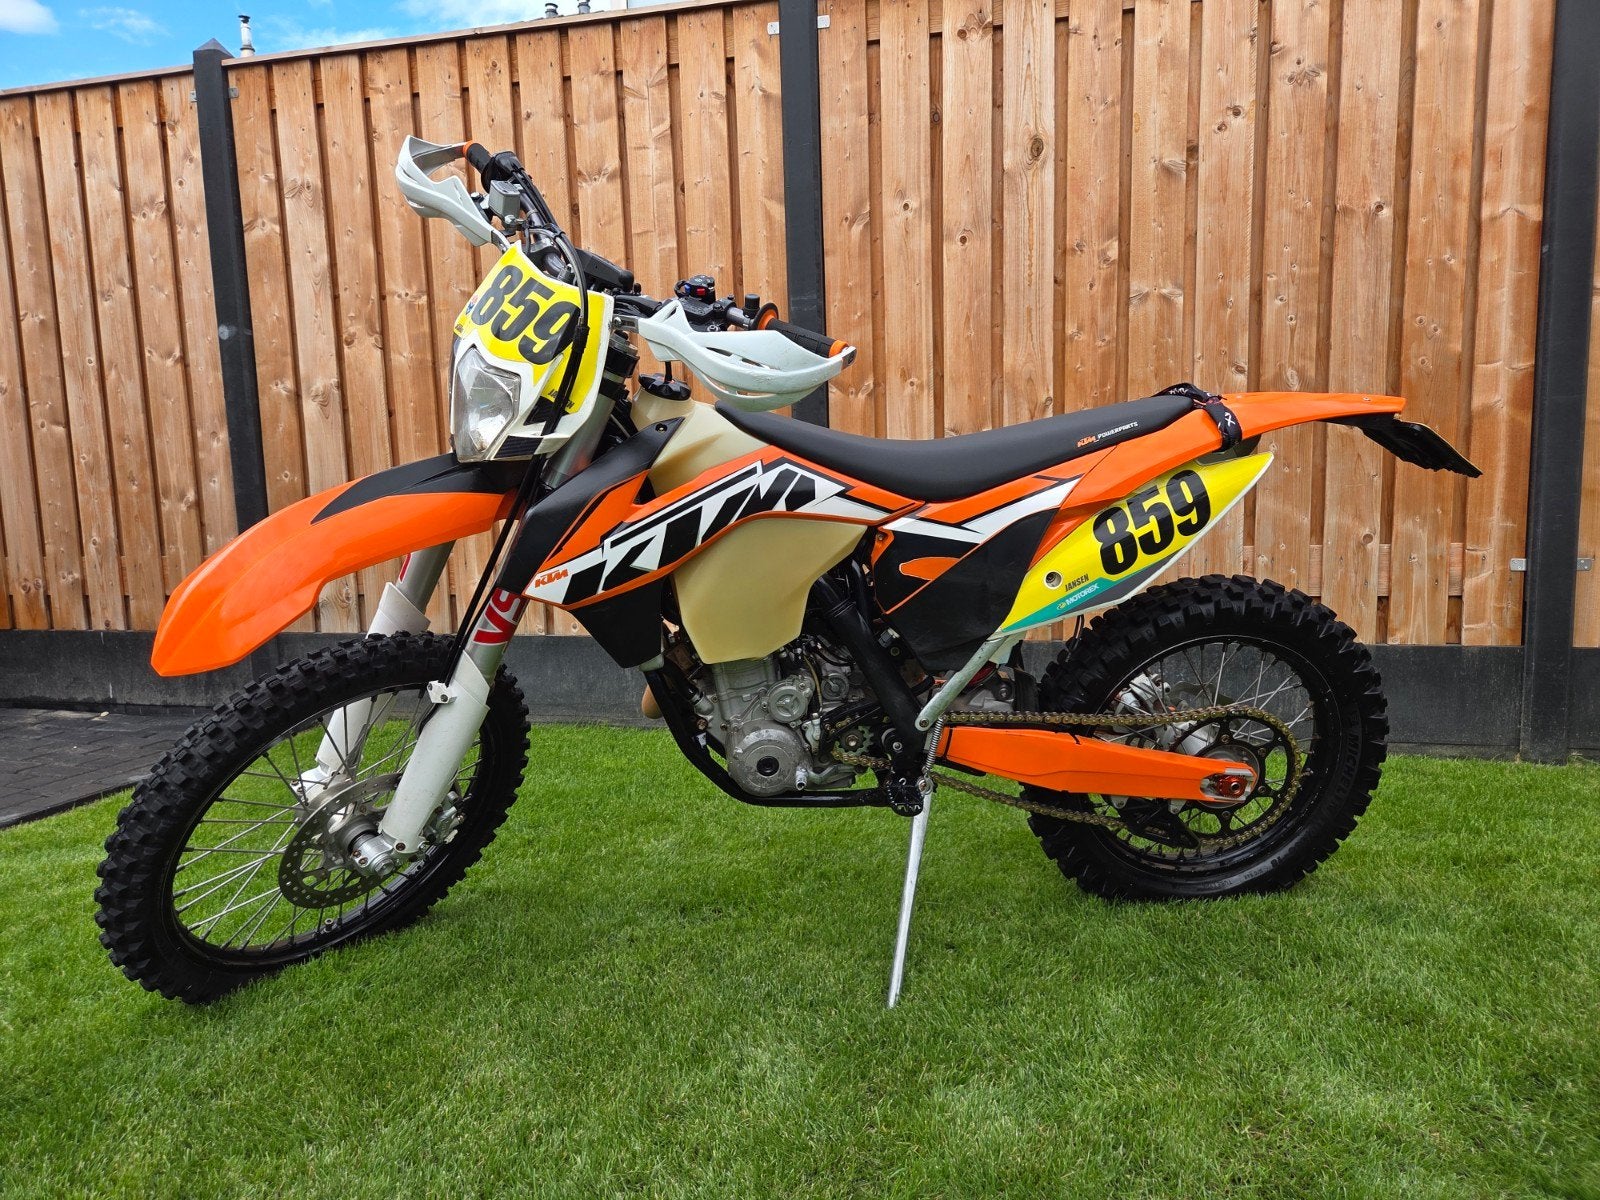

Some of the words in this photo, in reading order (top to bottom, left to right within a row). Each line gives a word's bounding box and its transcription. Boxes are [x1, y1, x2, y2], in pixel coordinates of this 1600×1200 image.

[471, 264, 583, 365] 859
[1092, 469, 1211, 576] 859
[534, 568, 569, 589] KTM
[1064, 573, 1089, 592] JANSEN
[1065, 583, 1100, 606] MOTOREX
